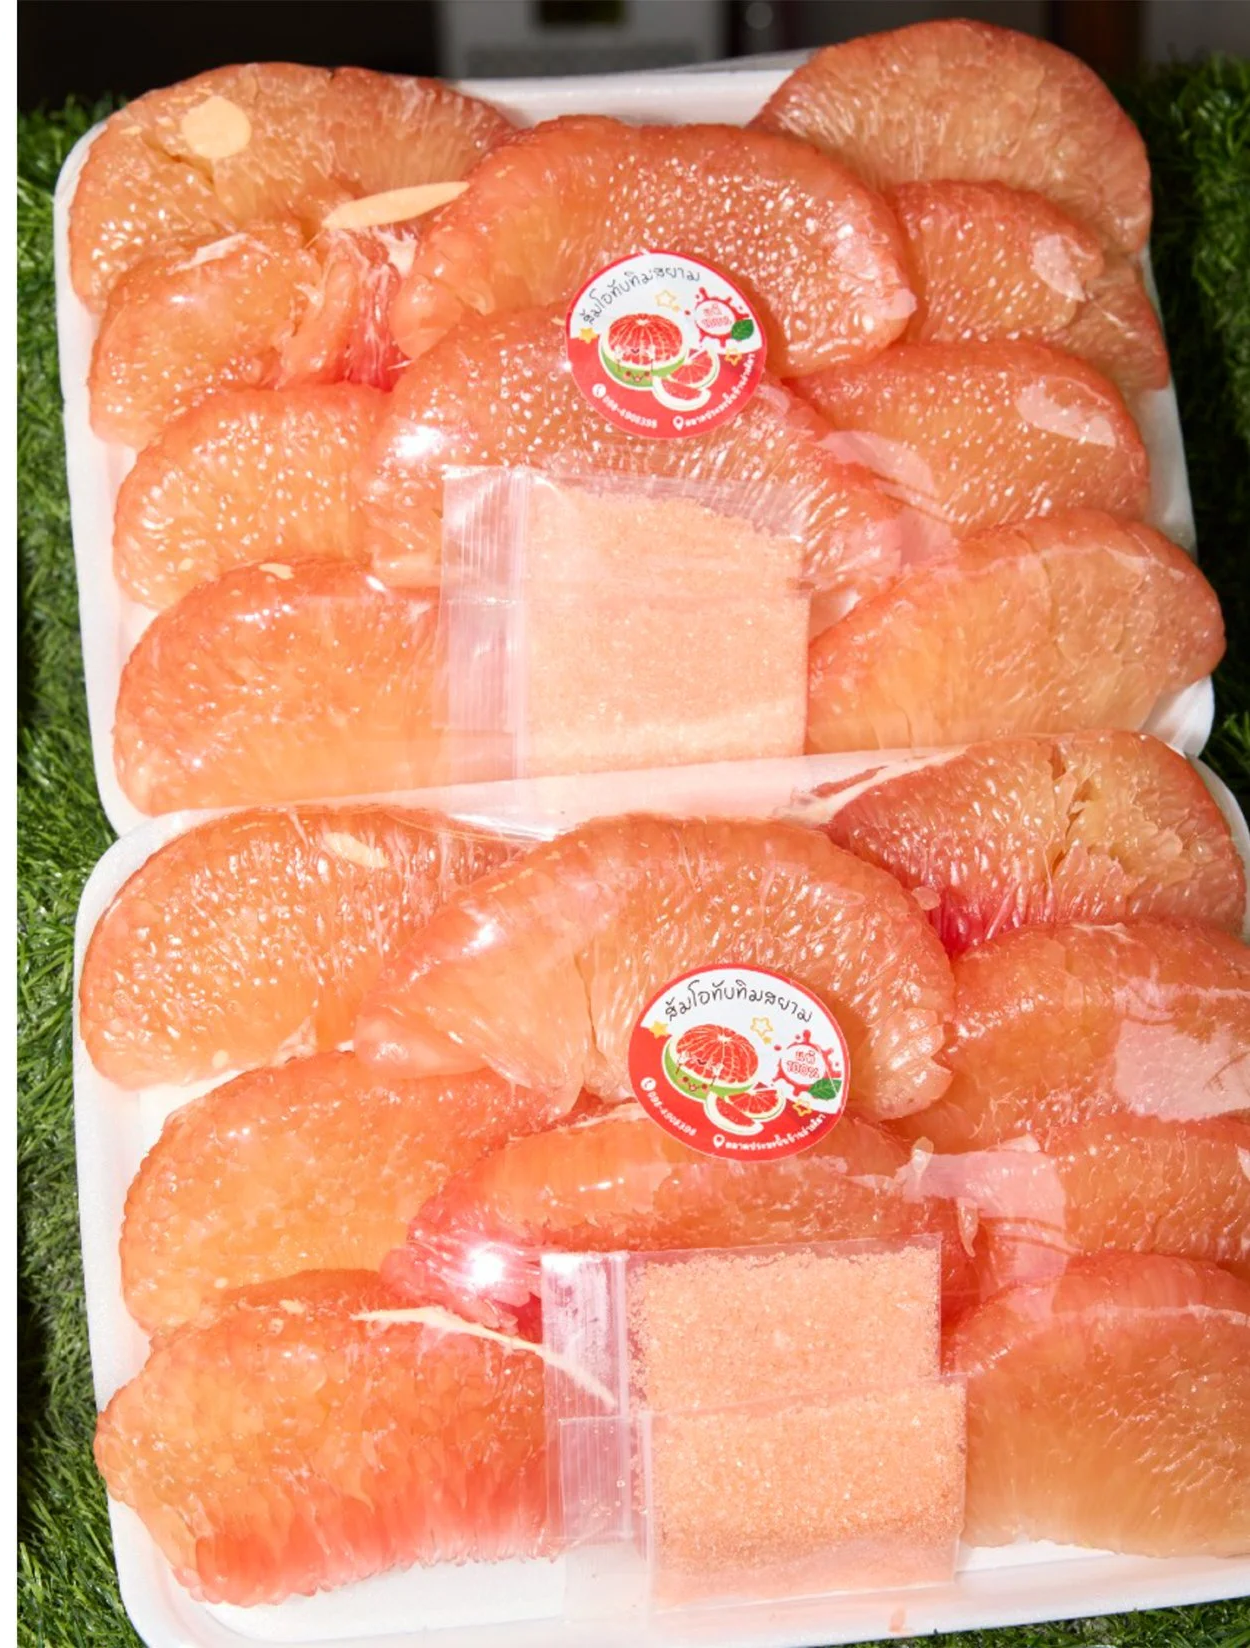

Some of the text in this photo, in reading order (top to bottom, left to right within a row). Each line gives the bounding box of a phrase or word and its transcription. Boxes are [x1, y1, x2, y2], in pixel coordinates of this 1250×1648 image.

[664, 978, 814, 1024] ส้มโอทับทิมสยาม
